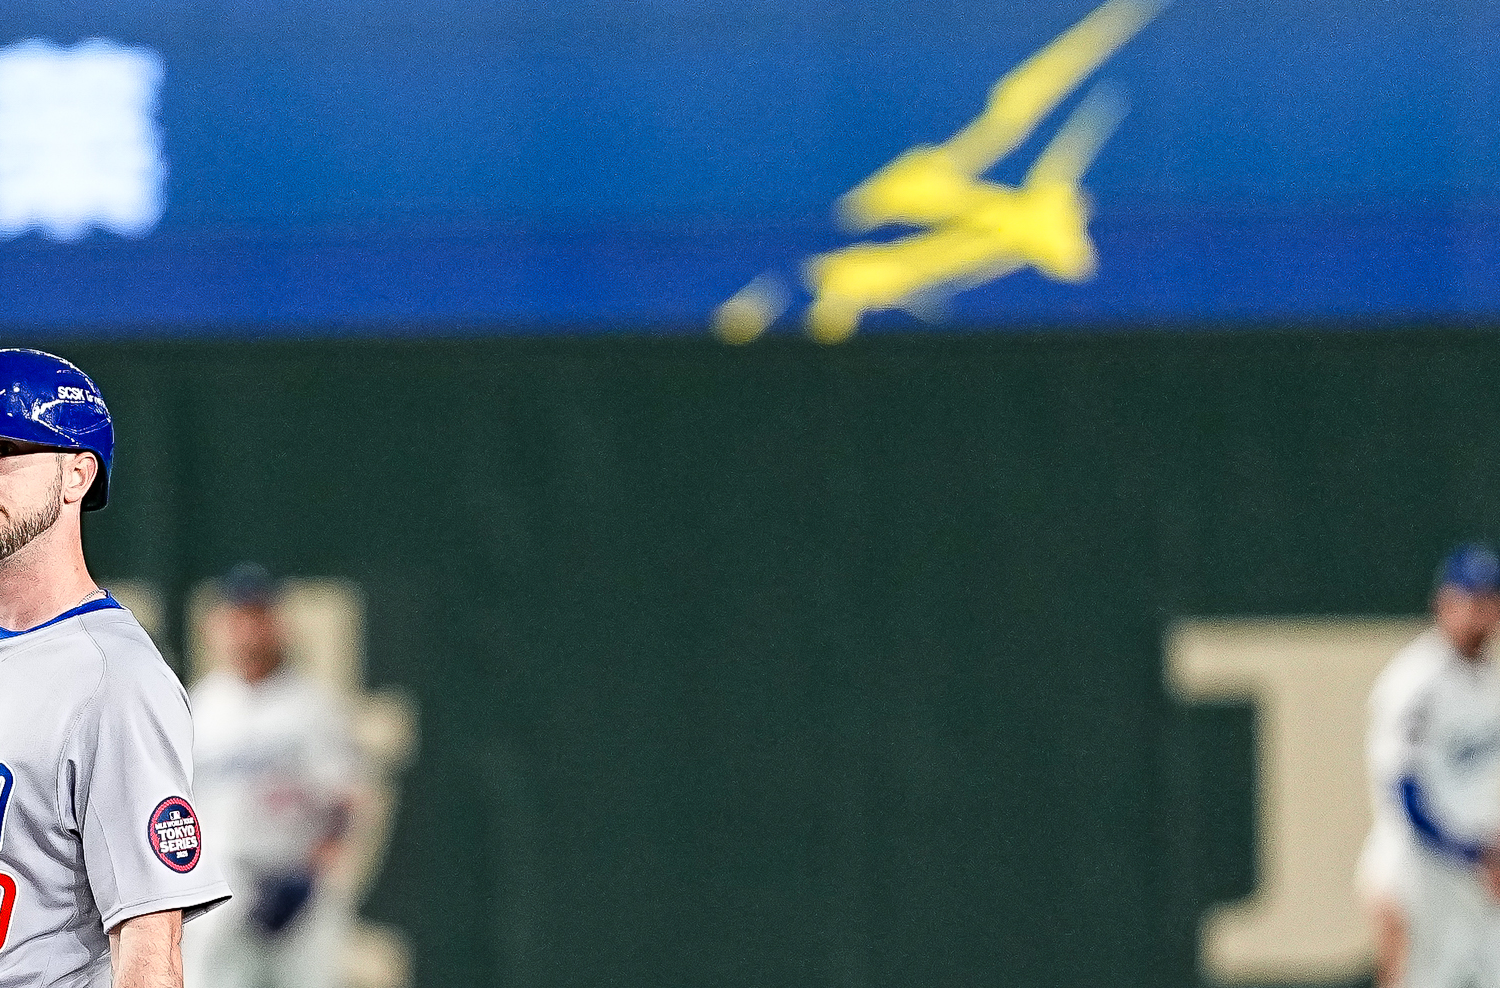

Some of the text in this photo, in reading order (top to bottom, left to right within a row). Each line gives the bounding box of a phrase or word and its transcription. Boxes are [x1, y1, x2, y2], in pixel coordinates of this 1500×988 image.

[57, 386, 85, 401] SCSK
[158, 825, 195, 841] TOKYO
[160, 836, 198, 853] SERIES
